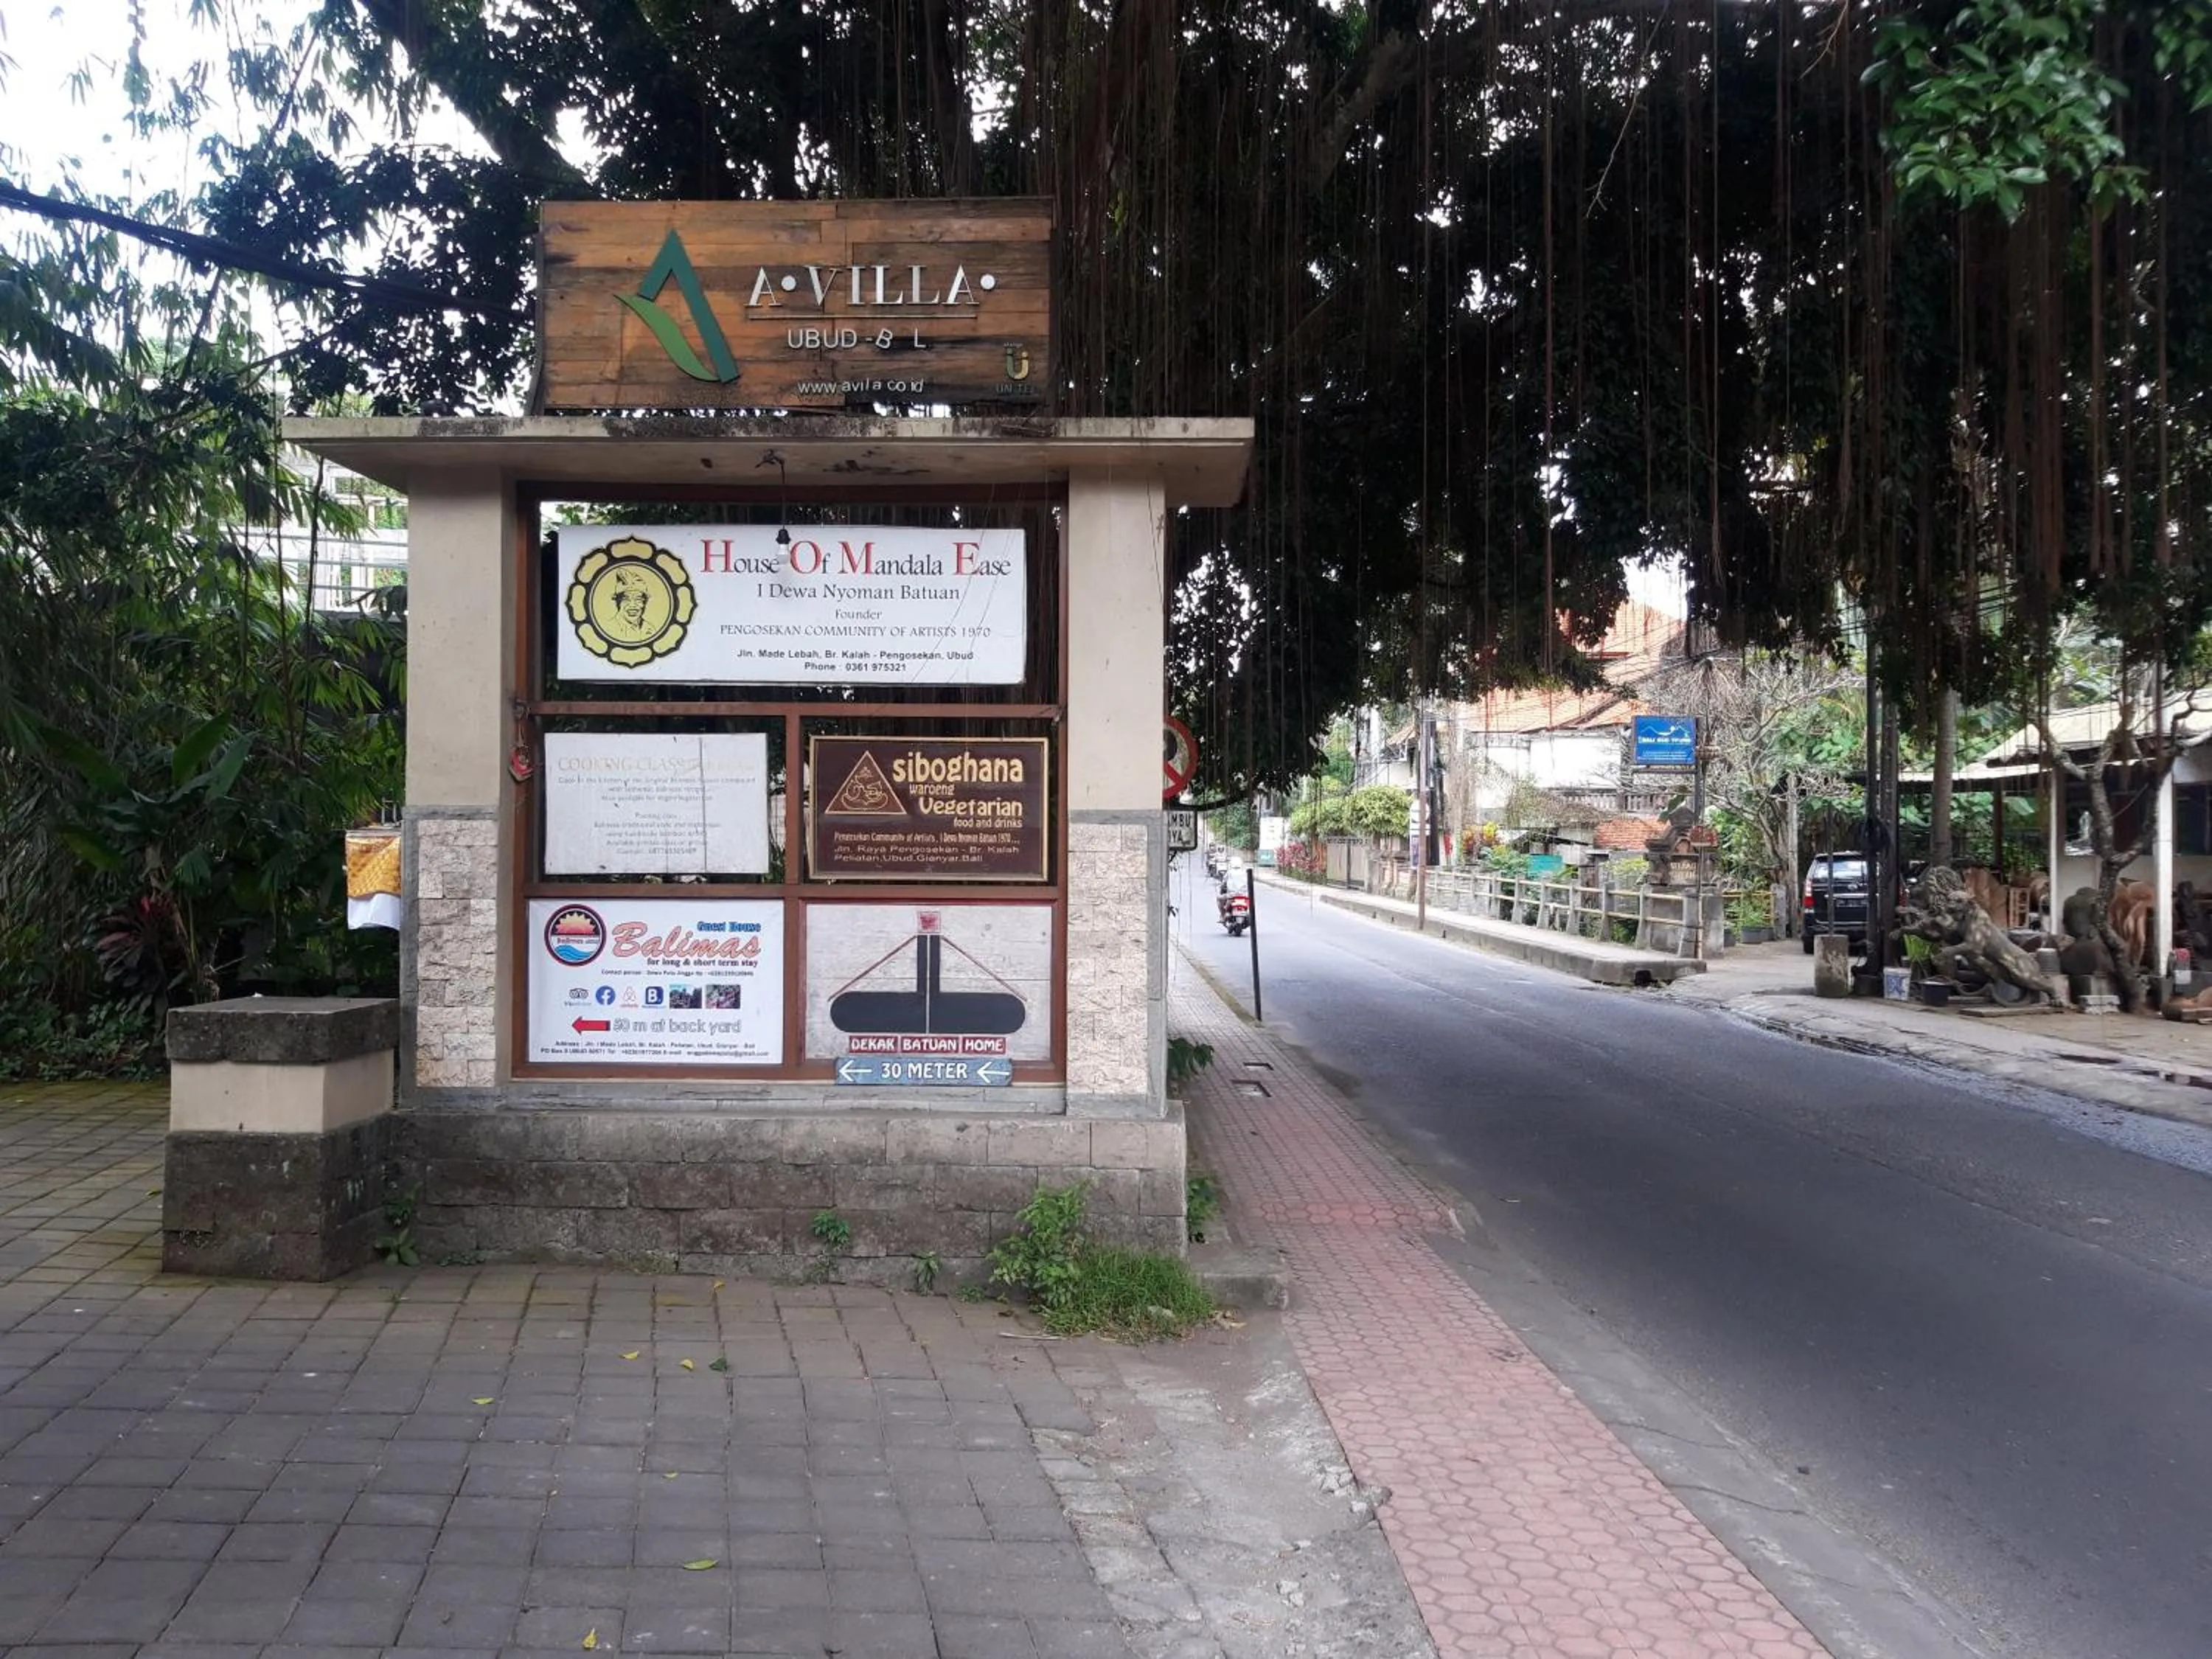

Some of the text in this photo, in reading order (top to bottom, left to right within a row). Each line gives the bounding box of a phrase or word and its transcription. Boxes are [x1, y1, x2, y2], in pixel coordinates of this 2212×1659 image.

[787, 329, 858, 349] UBUD
[700, 539, 1012, 576] House Of Mandala Ease
[757, 583, 959, 602] I Dewa Nyoman Batuan
[835, 608, 883, 621] Founder
[720, 625, 991, 638] PENGOSEKAN COMMUNITY OF ARTISTS 1970
[759, 650, 785, 658] Made
[842, 650, 870, 659] Kalah
[947, 652, 974, 660] Ubud
[804, 662, 836, 671] Phone
[846, 663, 868, 672] 0361
[892, 751, 1023, 783] siboghana
[909, 783, 955, 796] waroeng
[919, 796, 1023, 816] Vegetarian
[953, 817, 1023, 828] food and drinks
[611, 921, 762, 959] Balimas
[647, 958, 659, 966] for
[662, 959, 681, 967] long
[693, 959, 715, 967] short
[741, 960, 759, 968] stay
[669, 1018, 706, 1033] back
[709, 1019, 742, 1036] yard
[902, 1040, 957, 1051] BATUAN
[964, 1040, 1005, 1052] HOME
[881, 1062, 967, 1079] 30 METER
